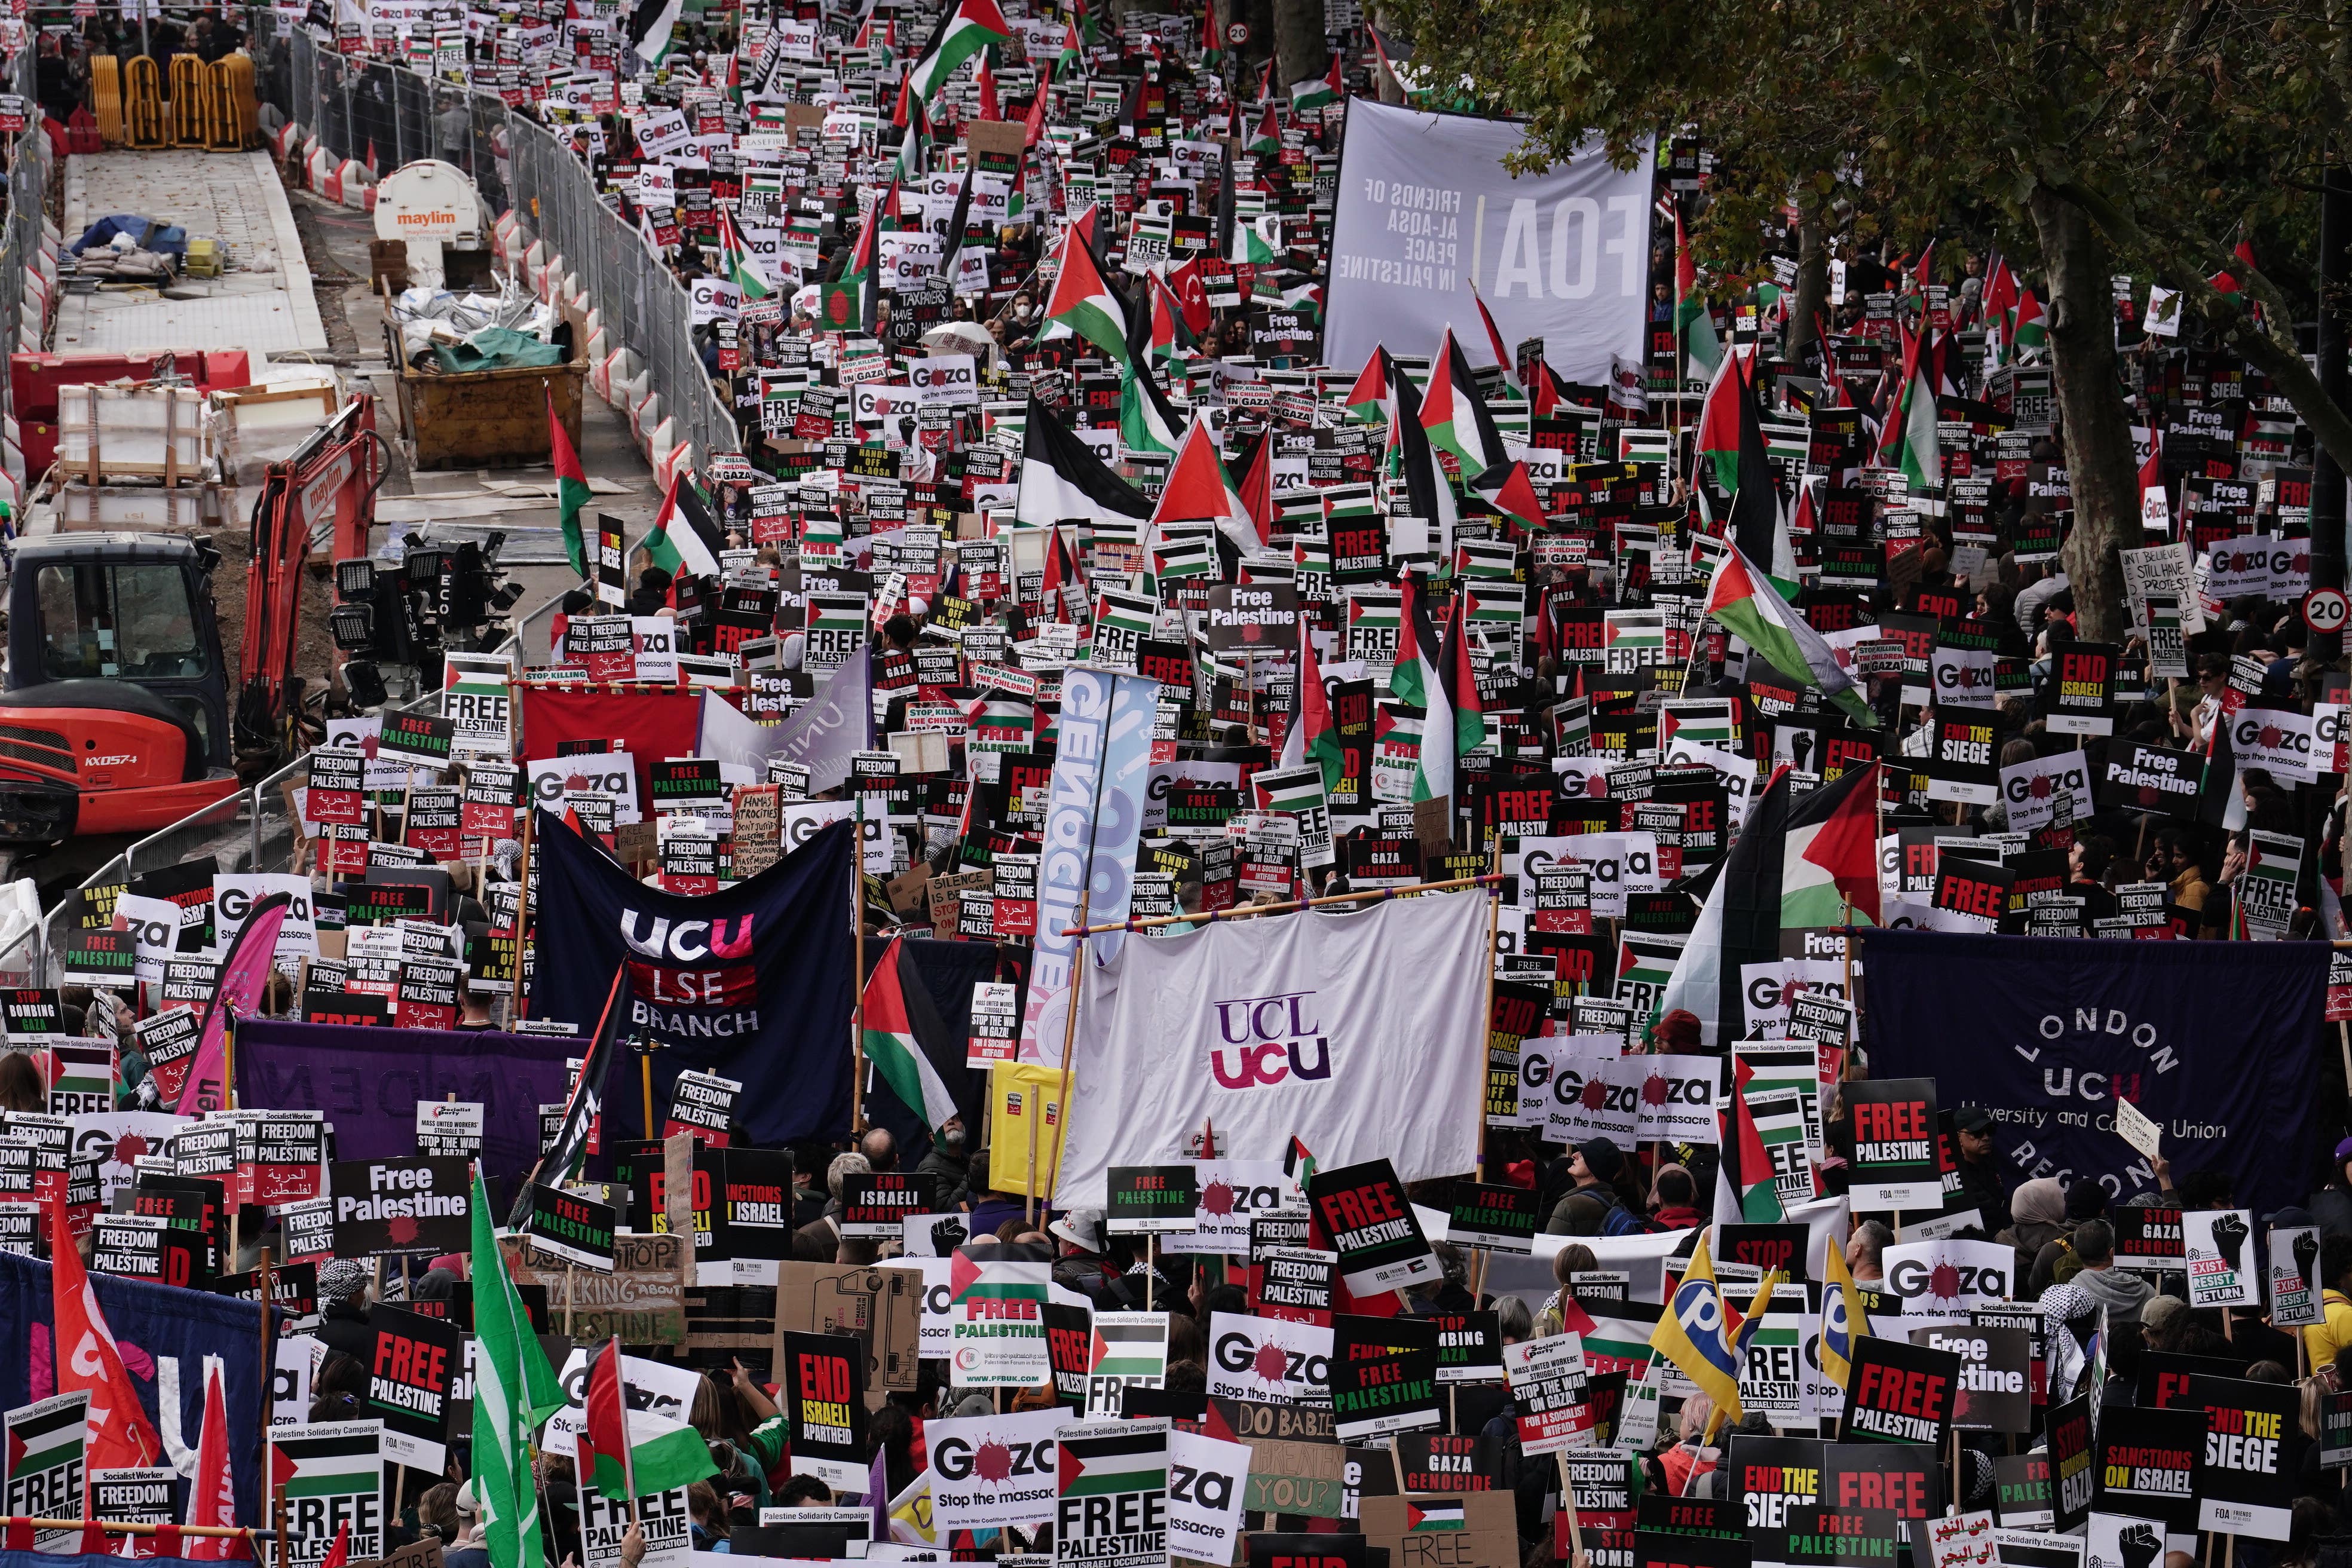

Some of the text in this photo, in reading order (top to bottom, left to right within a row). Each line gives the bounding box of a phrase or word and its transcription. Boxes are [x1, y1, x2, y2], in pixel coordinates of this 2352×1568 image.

[1140, 137, 1162, 148] SIEGE
[800, 198, 824, 210] Free
[397, 211, 455, 226] maylim
[1130, 239, 1166, 253] FREE
[1183, 237, 1206, 247] ISRAEL
[898, 290, 947, 307] TAXPAYERS
[891, 309, 912, 321] HAVE
[1269, 314, 1298, 327] Free
[896, 322, 915, 337] OUR
[1255, 329, 1313, 343] Palestine
[840, 357, 882, 369] STOP KILLING
[855, 363, 884, 375] CHILDREN
[857, 370, 885, 381] GAZA
[2188, 409, 2222, 424] Free
[859, 449, 888, 458] HANDS
[865, 458, 880, 467] OFF
[853, 466, 890, 477] AL-AQSA
[310, 463, 342, 510] maylim
[2213, 483, 2247, 498] Free
[1334, 529, 1380, 557] FREE
[601, 547, 620, 570] SIEGE
[1535, 554, 1585, 563] IN GAZA
[2143, 547, 2180, 562] BELIEVE
[1335, 556, 1382, 571] PALESTINE
[2137, 562, 2185, 578] STILL HAVE
[2142, 578, 2189, 590] PROTEST
[1231, 589, 1272, 606] Free
[1211, 607, 1294, 626] Palestine
[2311, 601, 2344, 620] 20
[637, 660, 671, 668] massacre
[2062, 654, 2106, 683] END
[526, 670, 587, 680] STOP KILLING
[2061, 681, 2103, 697] ISRAELI
[444, 696, 508, 721] FREE
[2059, 695, 2102, 708] APARTHEID
[381, 727, 449, 752] PALESTINE
[1942, 739, 1990, 765] SIEGE
[85, 755, 137, 767] KX057-4
[314, 757, 359, 772] FREEDOM
[2133, 748, 2178, 772] Free
[311, 774, 360, 790] PALESTINE
[2106, 764, 2197, 795] Palestine
[318, 792, 351, 805] الحرية
[744, 796, 772, 807] HAMAS
[313, 806, 355, 817] لفلسطين
[734, 808, 777, 820] ATROCITIES
[1246, 843, 1293, 856] STOP THE WAR
[1253, 853, 1283, 864] ON GAZA!
[1255, 873, 1278, 881] INTIFADA
[1358, 864, 1413, 877] GENOCIDE
[1539, 876, 1585, 890] FREEDOM
[1538, 893, 1588, 908] PALESTINE
[68, 951, 134, 967] PALESTINE
[654, 969, 724, 1004] LSE
[16, 991, 41, 1004] STOP
[10, 1004, 55, 1017] BOMBING
[1213, 991, 1319, 1045] UCL
[23, 1018, 48, 1031] GAZA
[632, 1000, 759, 1037] BRANCH
[2014, 1007, 2179, 1075] LONDON
[1554, 1068, 1639, 1113] Gza
[1549, 1113, 1634, 1134] Stop the massacre
[2057, 1110, 2227, 1139] and Union
[262, 1124, 316, 1139] FREEDOM
[258, 1147, 318, 1162] PALESTINE
[1855, 1141, 1930, 1162] PALESTINE
[267, 1168, 307, 1181] الحرية
[369, 1165, 433, 1192] Free
[263, 1183, 312, 1198] لفلسطين
[860, 1191, 918, 1206] ISRAELI
[338, 1191, 467, 1223] Palestine
[1334, 1219, 1413, 1253] PALESTINE
[2189, 1259, 2227, 1275] EXIST.
[540, 1273, 680, 1305] TALKING ABOUT
[2193, 1273, 2235, 1290] RESIST.
[2195, 1286, 2244, 1304] RETURN.
[1531, 1340, 1566, 1352] Socialist
[1530, 1368, 1557, 1380] STRUGGLE
[1546, 1391, 1576, 1408] GAZA!
[8, 1395, 87, 1423] Palestine Solidarity Campaign
[1279, 1408, 1337, 1437] BABIE
[1255, 1442, 1345, 1476] THREATEN
[2106, 1446, 2192, 1469] SANCTIONS
[1407, 1474, 1492, 1492] GENOCIDE
[2105, 1466, 2192, 1493] ON ISRAEL
[99, 1484, 168, 1505] FREEDOM
[1255, 1480, 1329, 1509] YOU?
[1058, 1490, 1166, 1539] FREE
[1058, 1532, 1166, 1560] PALESTINE
[1788, 1535, 1894, 1557] PALESTINE
[1113, 1554, 1165, 1566] OCCUPATION
